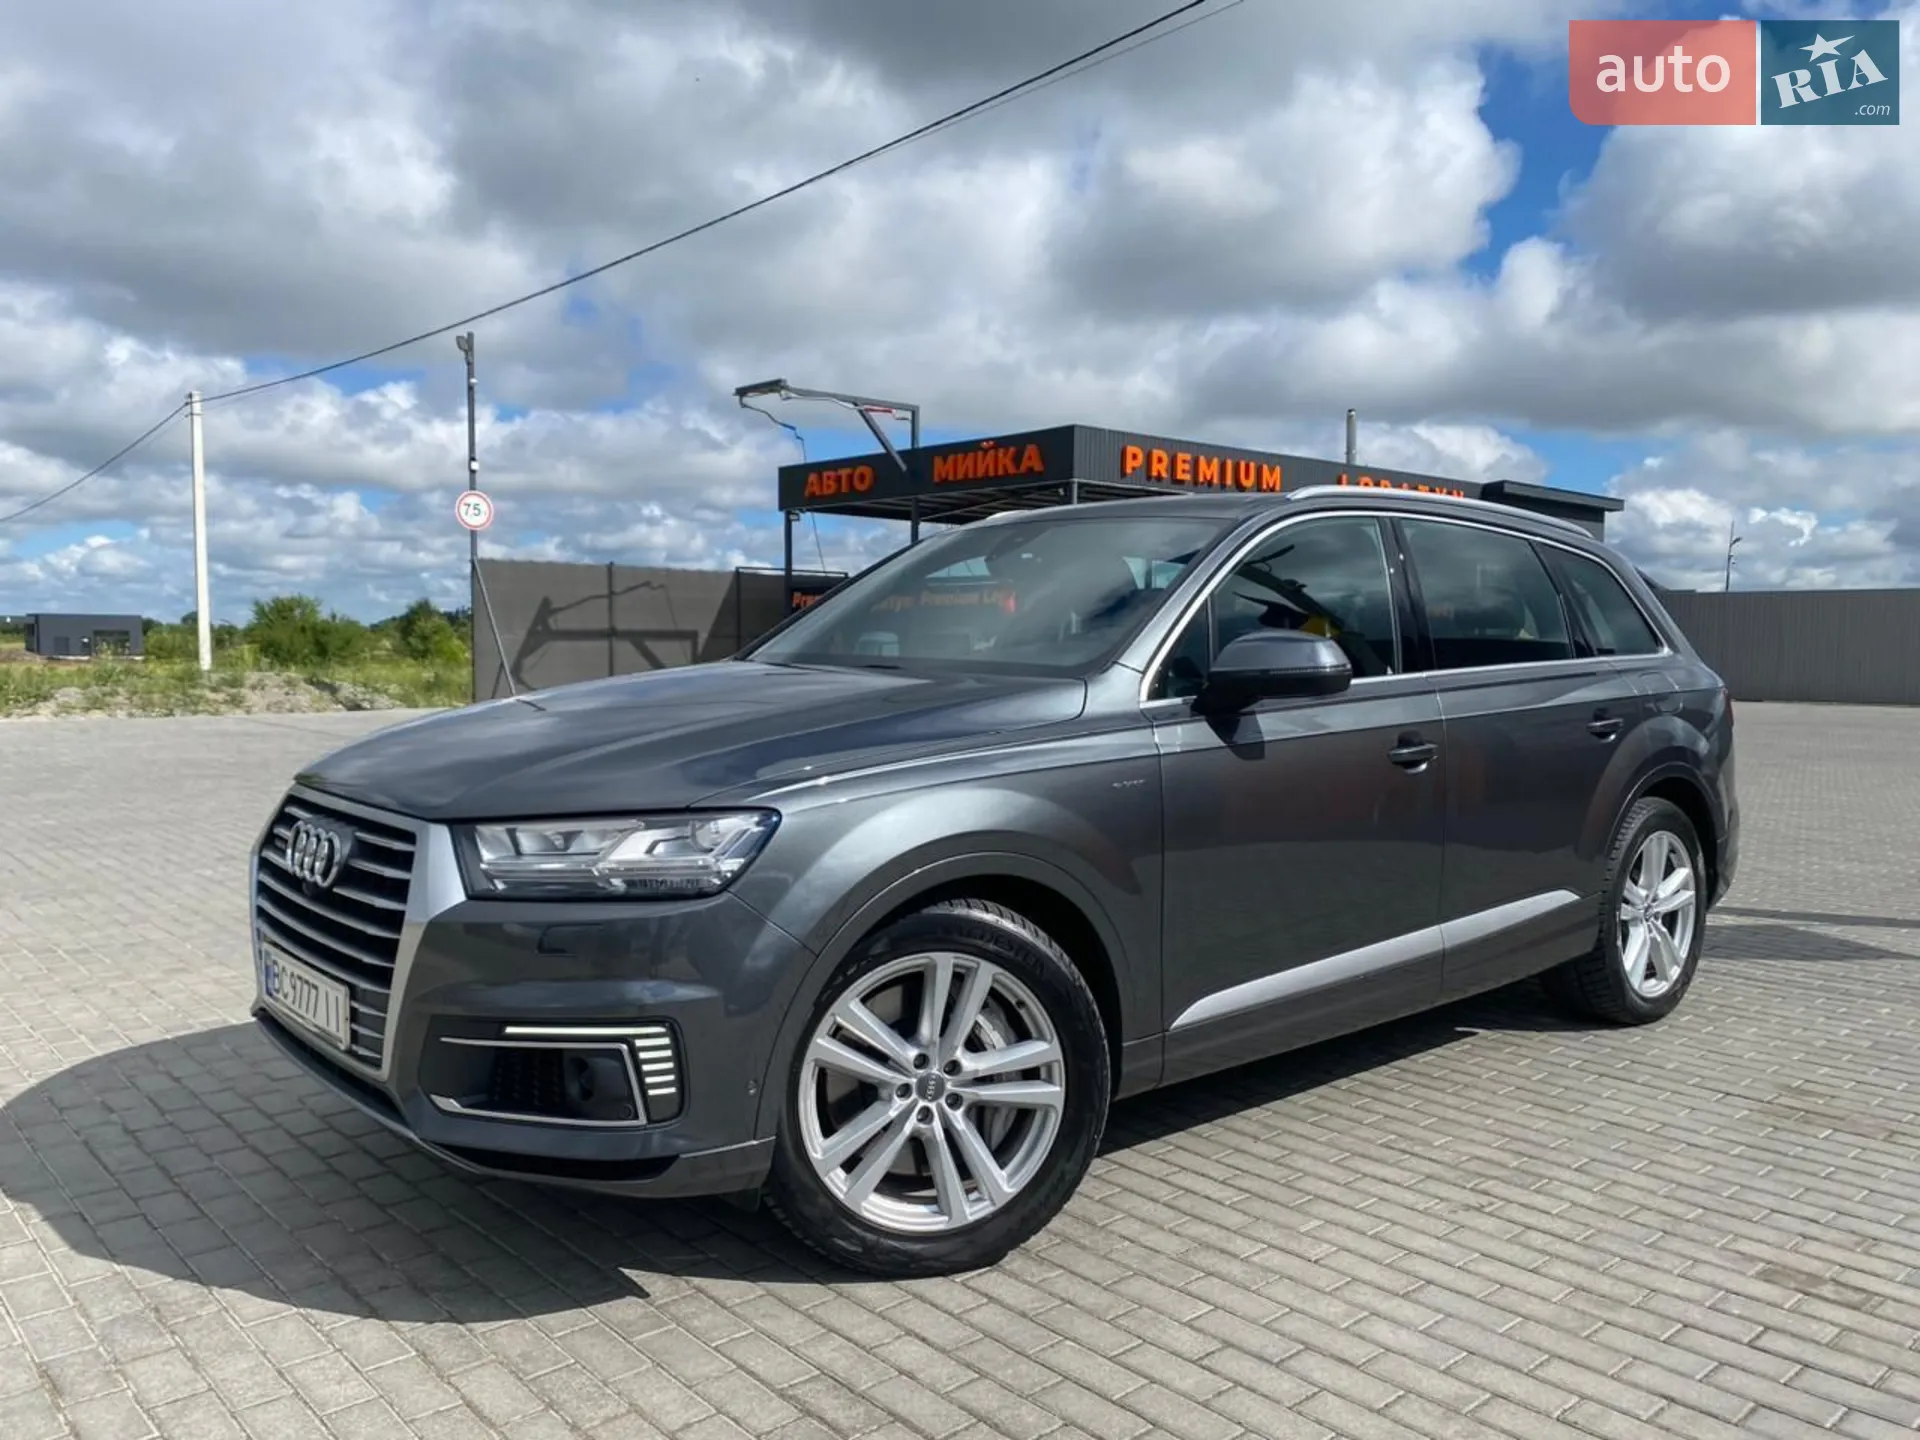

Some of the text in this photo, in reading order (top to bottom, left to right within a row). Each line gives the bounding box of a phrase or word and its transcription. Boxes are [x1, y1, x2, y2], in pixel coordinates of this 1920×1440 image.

[804, 440, 1045, 497] АВТО МИЙКА
[1121, 444, 1283, 493] PREMIUM
